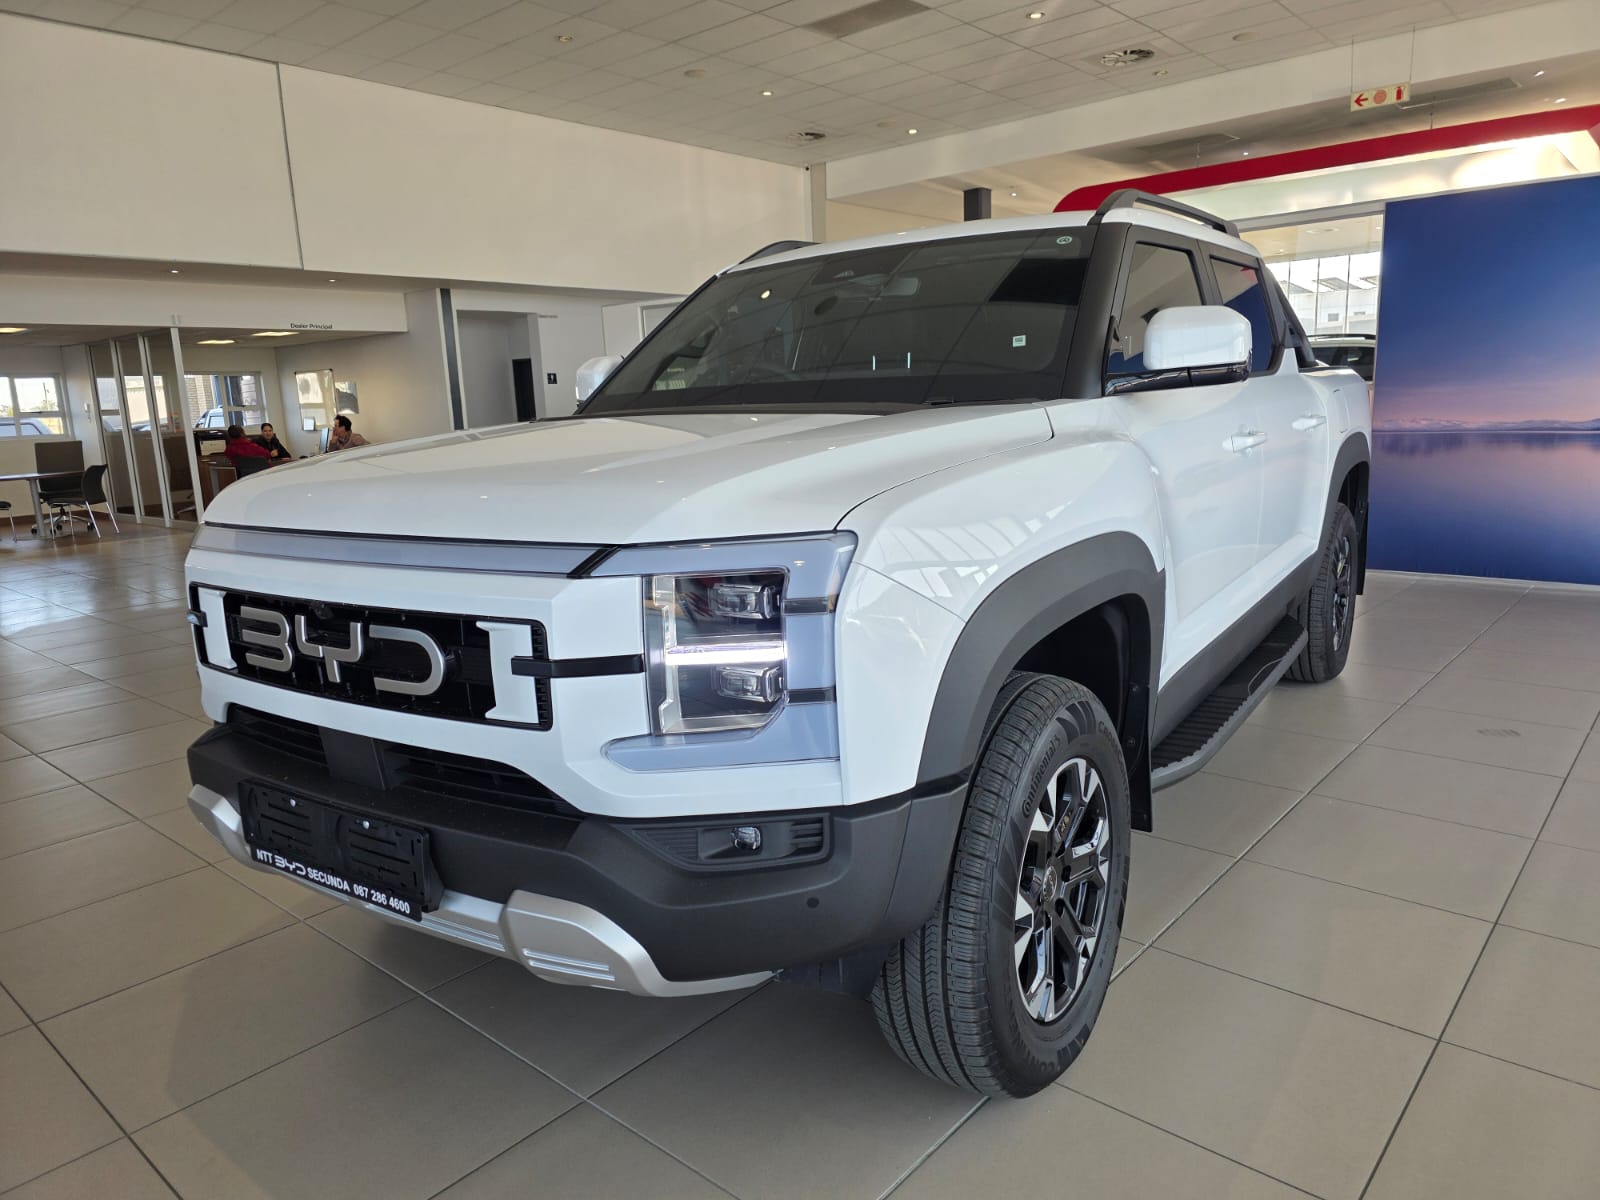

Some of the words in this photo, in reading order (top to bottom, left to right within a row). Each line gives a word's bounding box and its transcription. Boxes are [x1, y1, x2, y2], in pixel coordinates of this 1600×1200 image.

[240, 605, 446, 696] BYD
[256, 848, 272, 864] NTT
[274, 854, 307, 876] BYD
[307, 867, 350, 892] SECUNDA
[353, 883, 369, 899] 087
